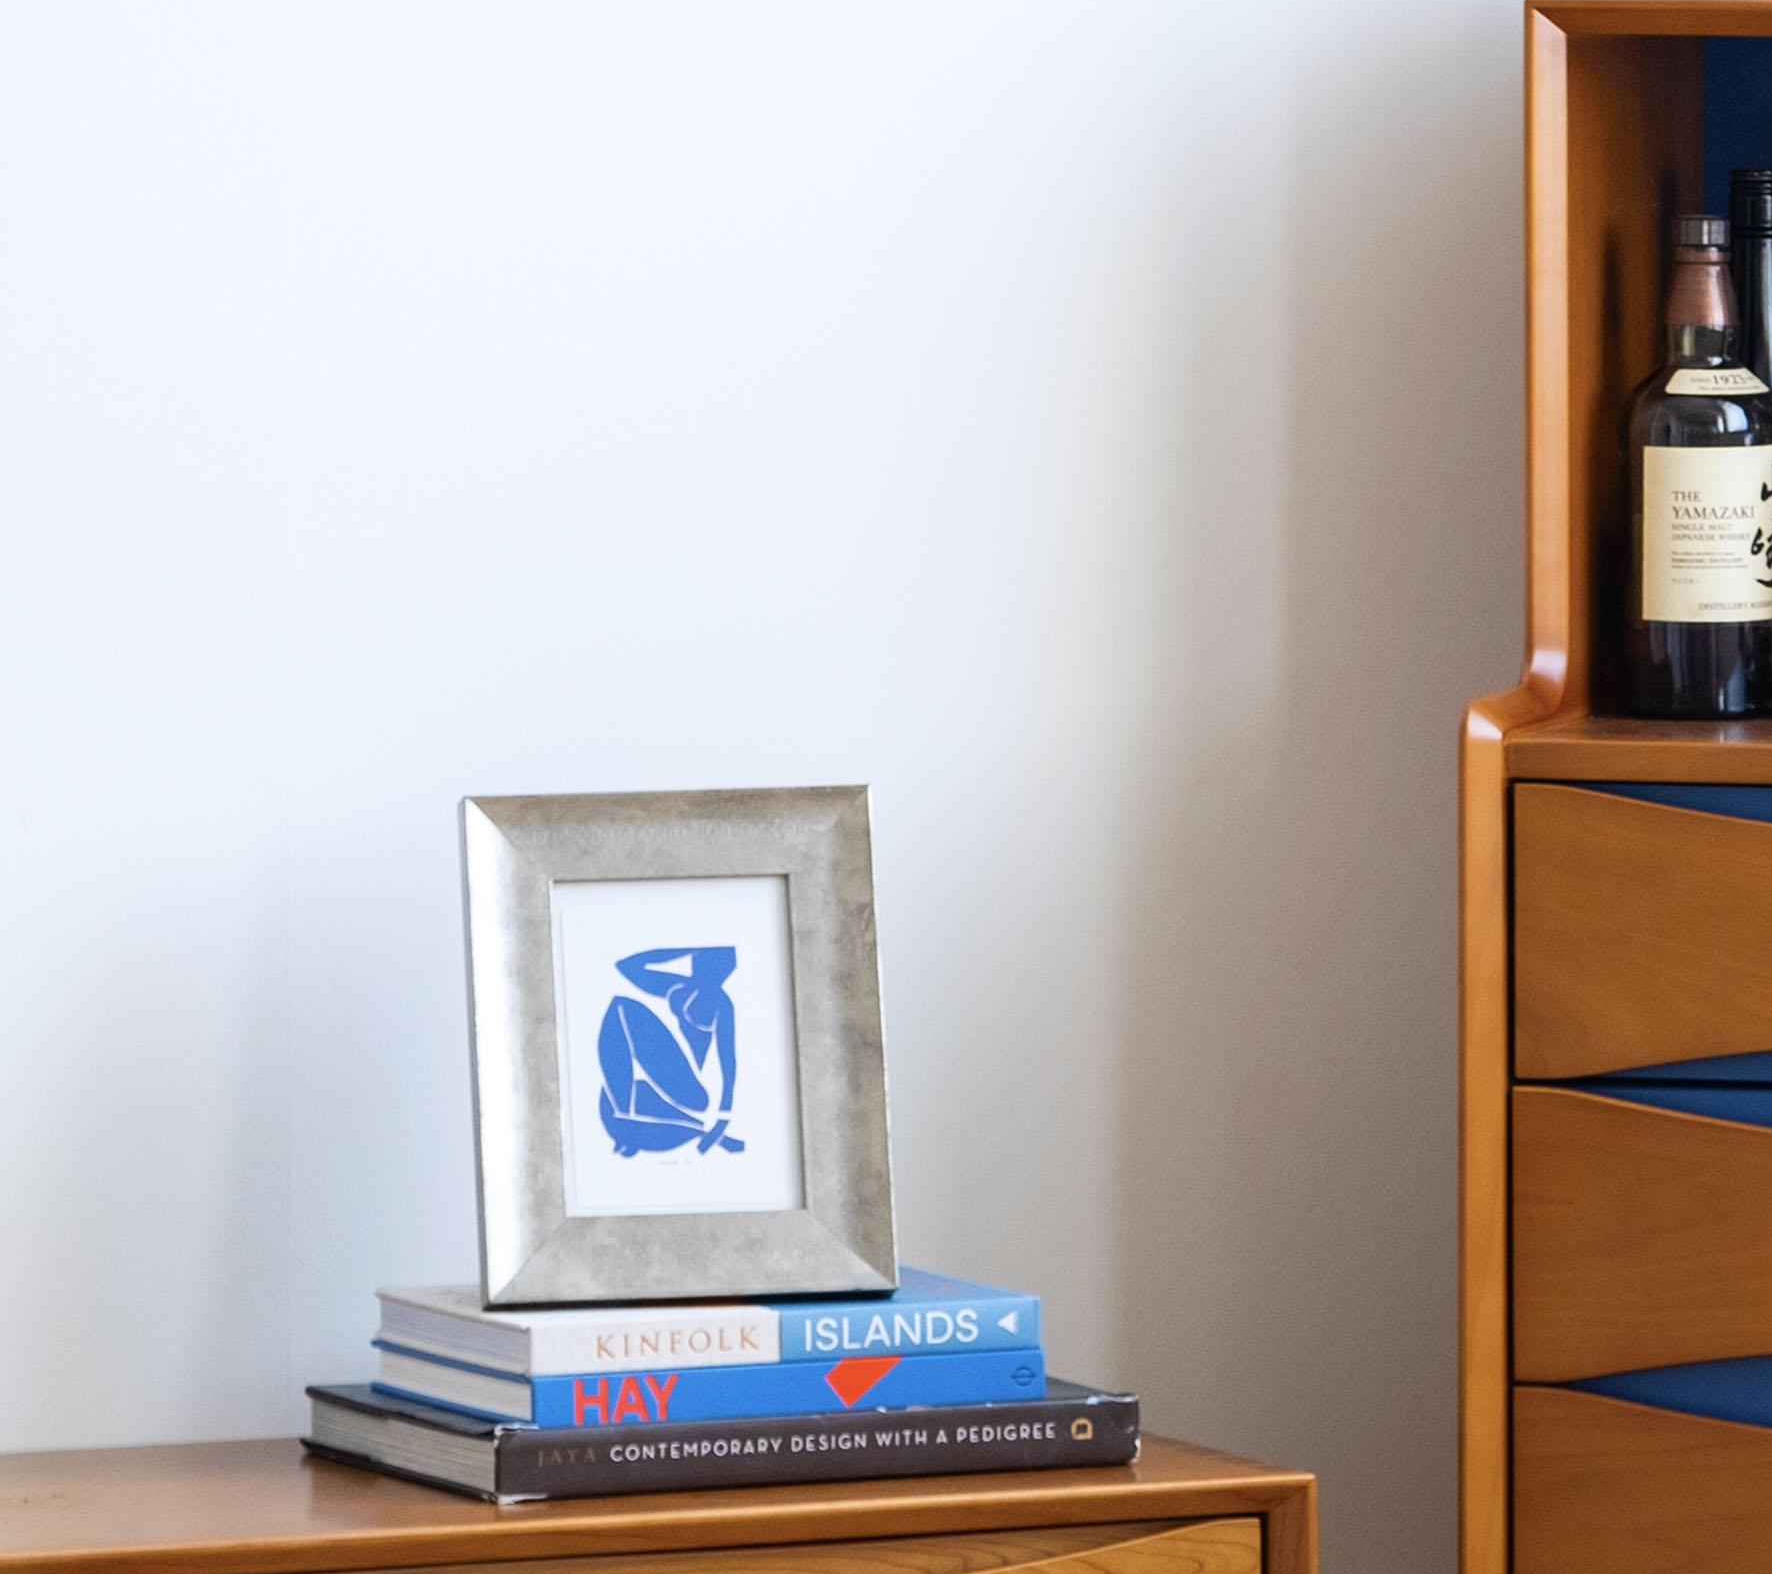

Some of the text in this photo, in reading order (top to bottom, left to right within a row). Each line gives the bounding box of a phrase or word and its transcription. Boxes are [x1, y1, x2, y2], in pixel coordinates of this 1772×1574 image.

[1672, 490, 1702, 503] THE
[1672, 505, 1755, 520] YAMAZAKI
[596, 1326, 759, 1360] KINFOLK
[804, 1309, 980, 1352] ISLANDS
[573, 1374, 680, 1425] HAY
[609, 1436, 783, 1462] CONTEMPORARY
[790, 1432, 867, 1453] DESIGN
[875, 1428, 928, 1447] WITH
[936, 1428, 948, 1444] A
[956, 1421, 1056, 1443] PEDIGREE
